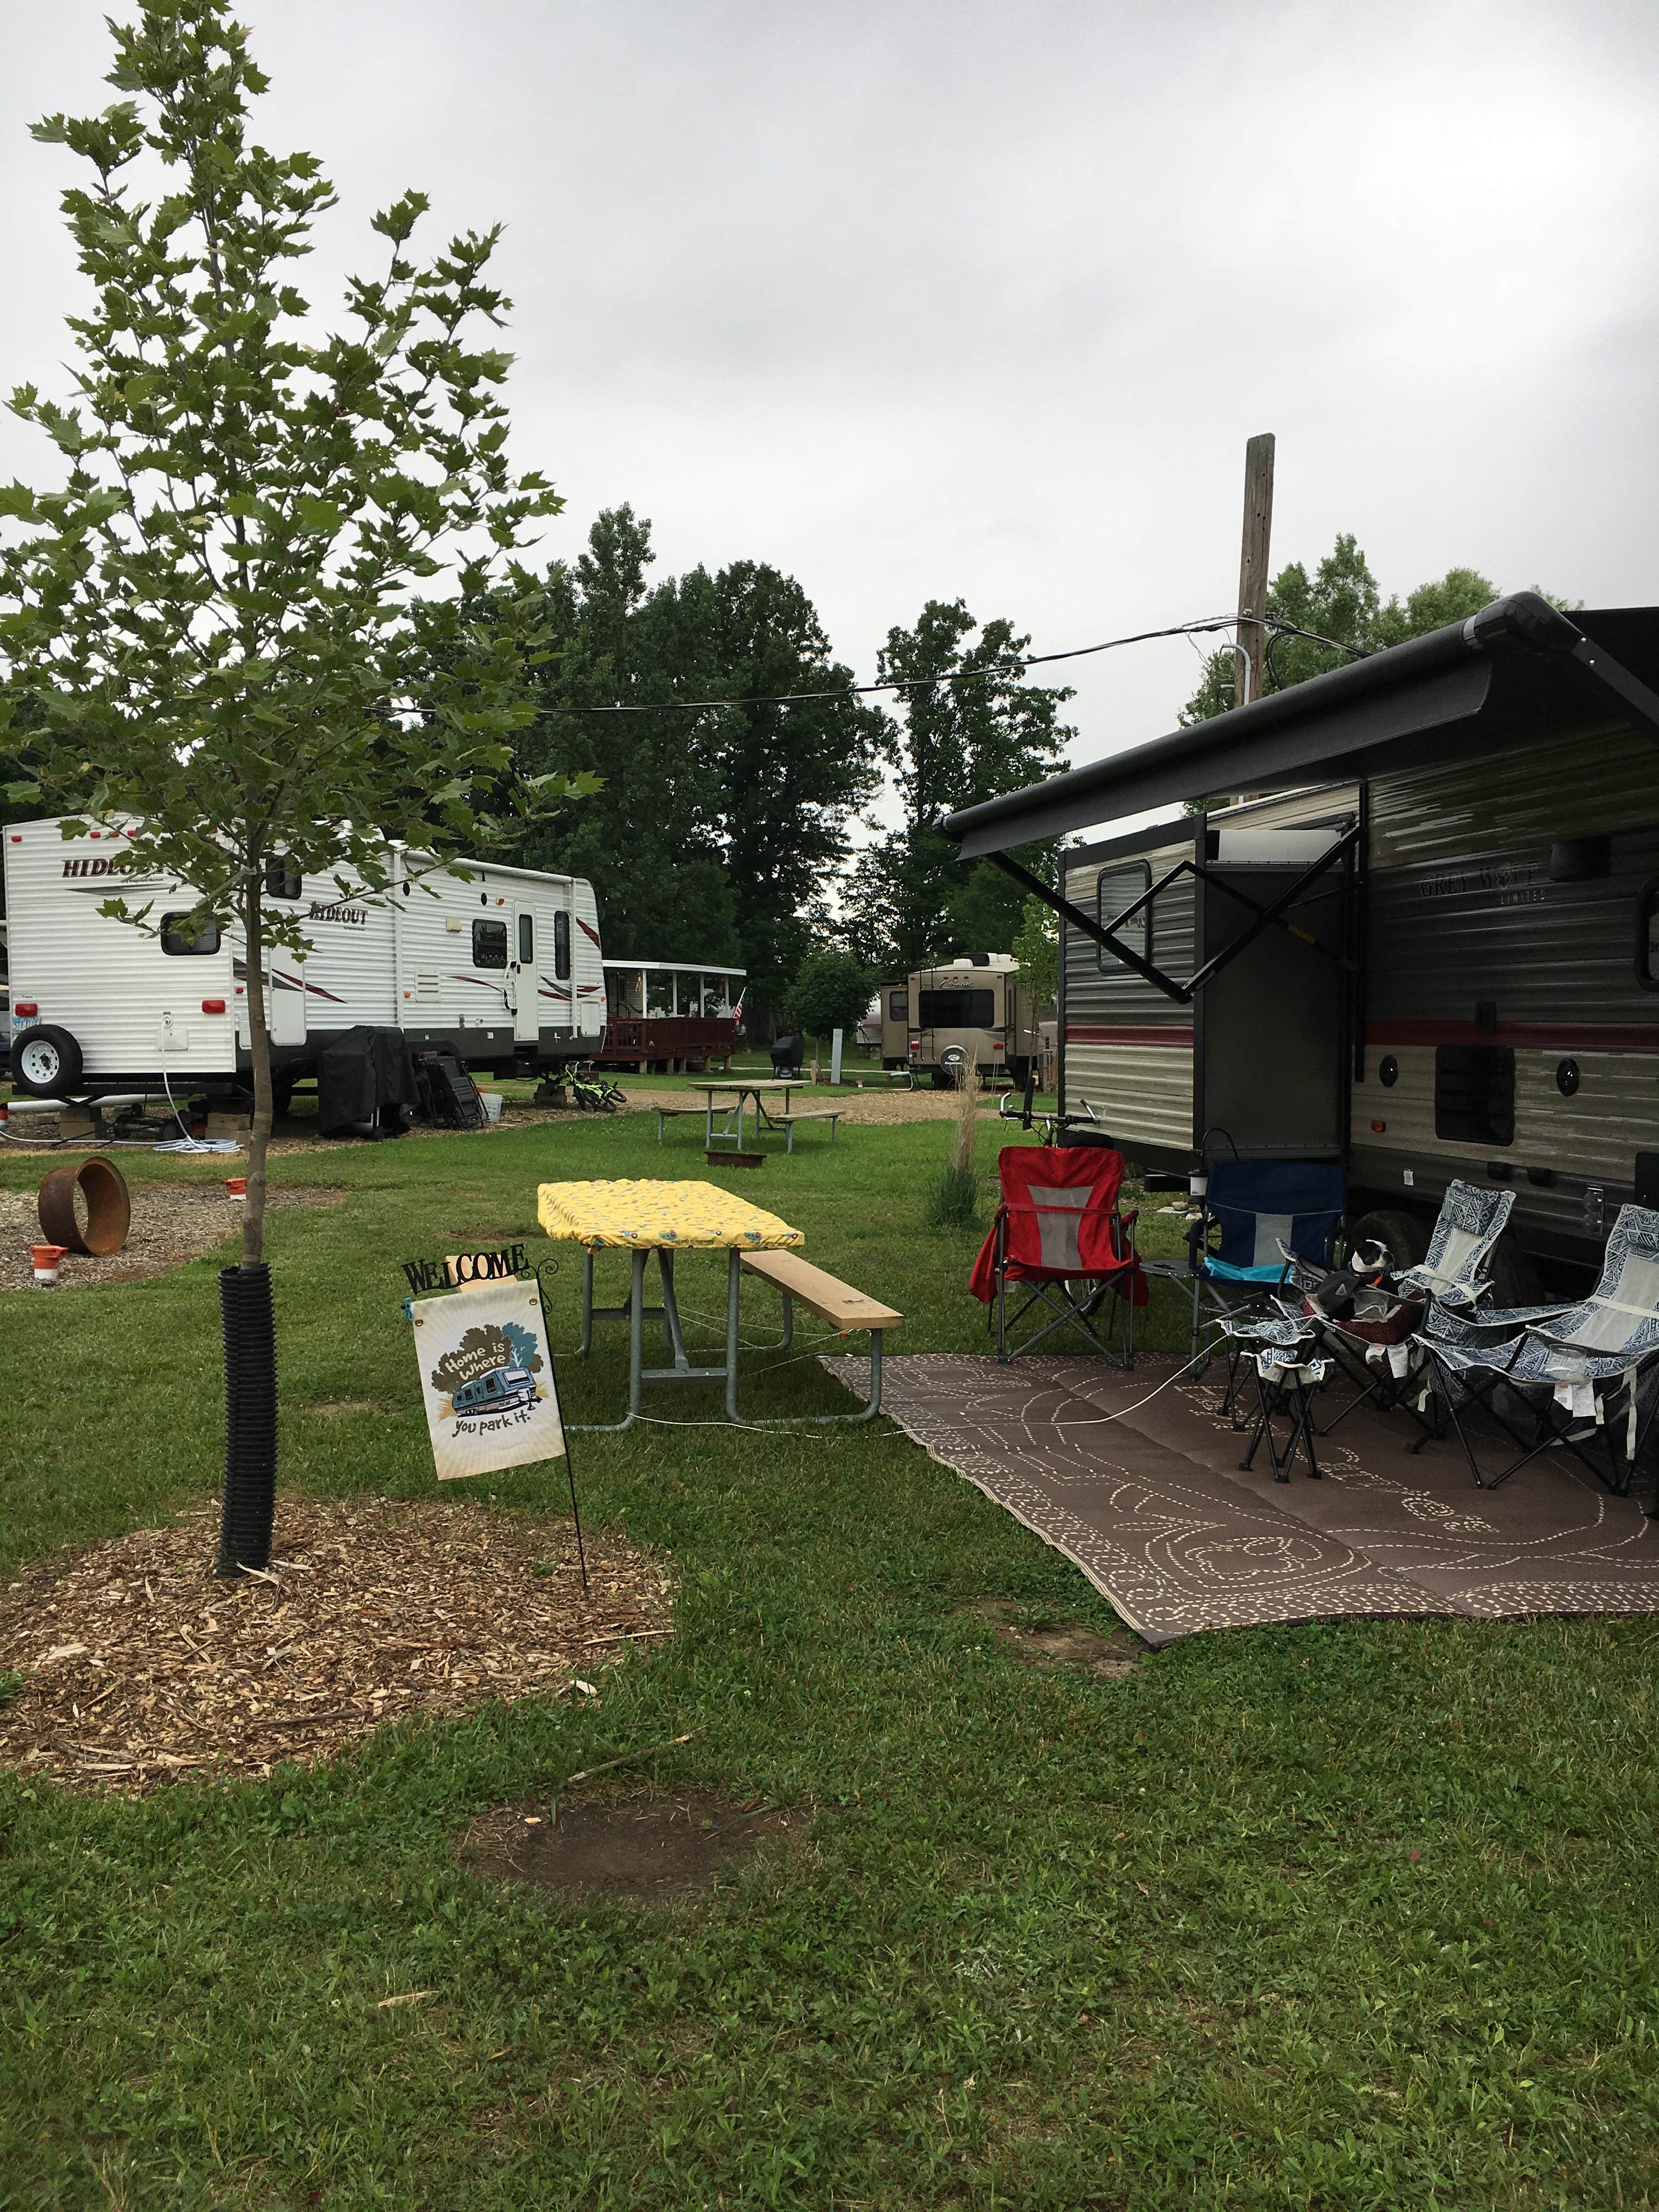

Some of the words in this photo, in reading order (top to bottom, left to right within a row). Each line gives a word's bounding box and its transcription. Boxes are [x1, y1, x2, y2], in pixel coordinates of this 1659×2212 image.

[1501, 889, 1546, 905] LIMITED
[939, 979, 974, 989] Cougar
[401, 1243, 529, 1295] WELCOME
[445, 1347, 486, 1373] Home
[492, 1342, 505, 1353] is
[452, 1420, 476, 1437] you
[479, 1414, 513, 1436] park
[514, 1409, 531, 1423] it.
